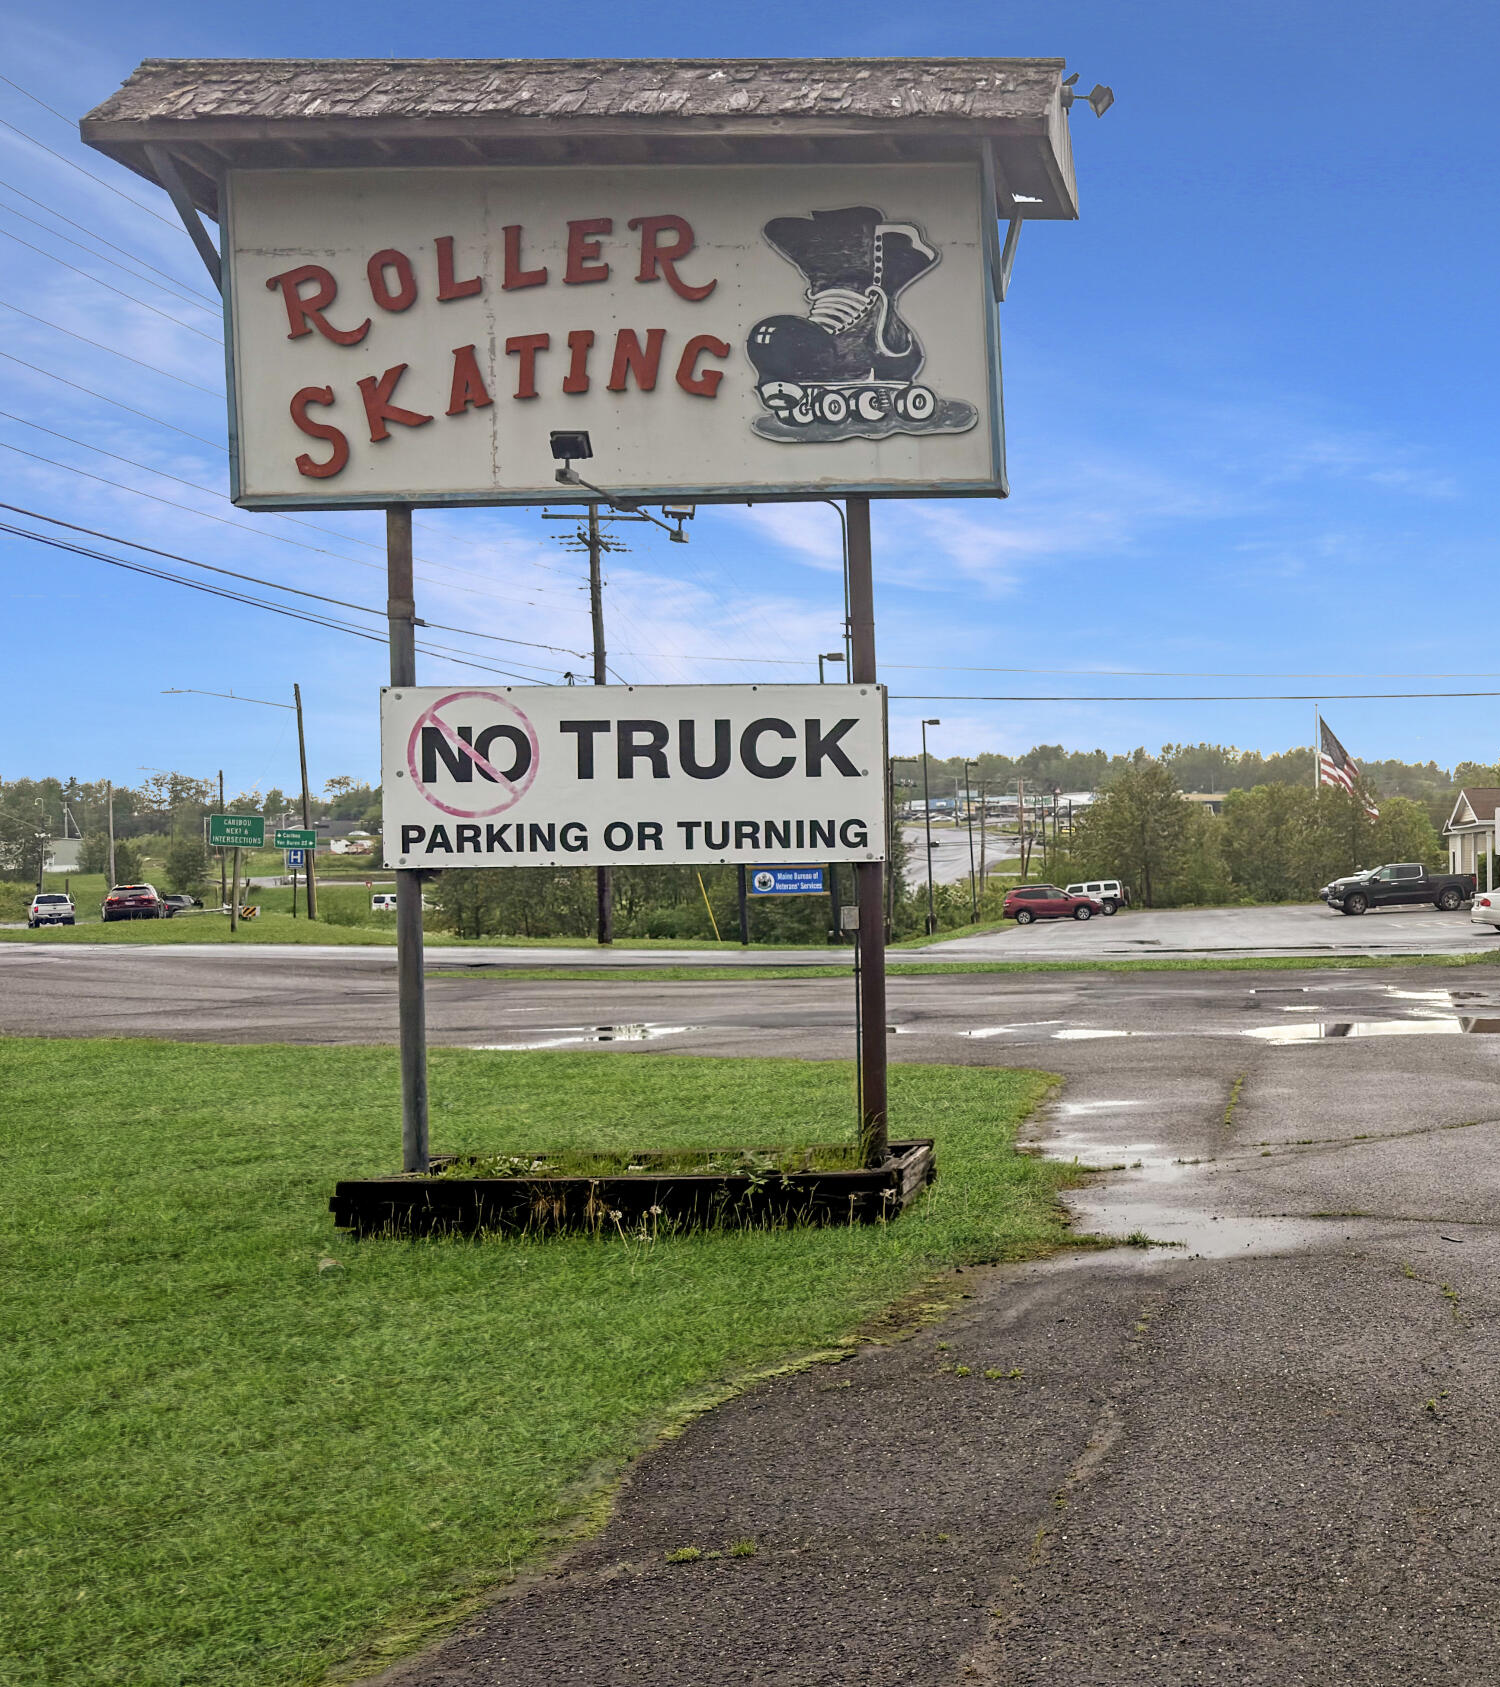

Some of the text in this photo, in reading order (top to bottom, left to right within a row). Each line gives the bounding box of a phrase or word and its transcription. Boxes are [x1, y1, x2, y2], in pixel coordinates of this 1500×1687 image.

[265, 214, 717, 346] ROLLER
[289, 327, 731, 479] SKATING
[421, 718, 863, 784] NO TRUCK
[212, 835, 262, 844] INTERSECTIONS
[400, 818, 869, 855] PARKING OR TURNING
[290, 850, 301, 863] H
[777, 872, 792, 880] Maine
[794, 872, 812, 880] Bureau
[800, 882, 823, 890] Services
